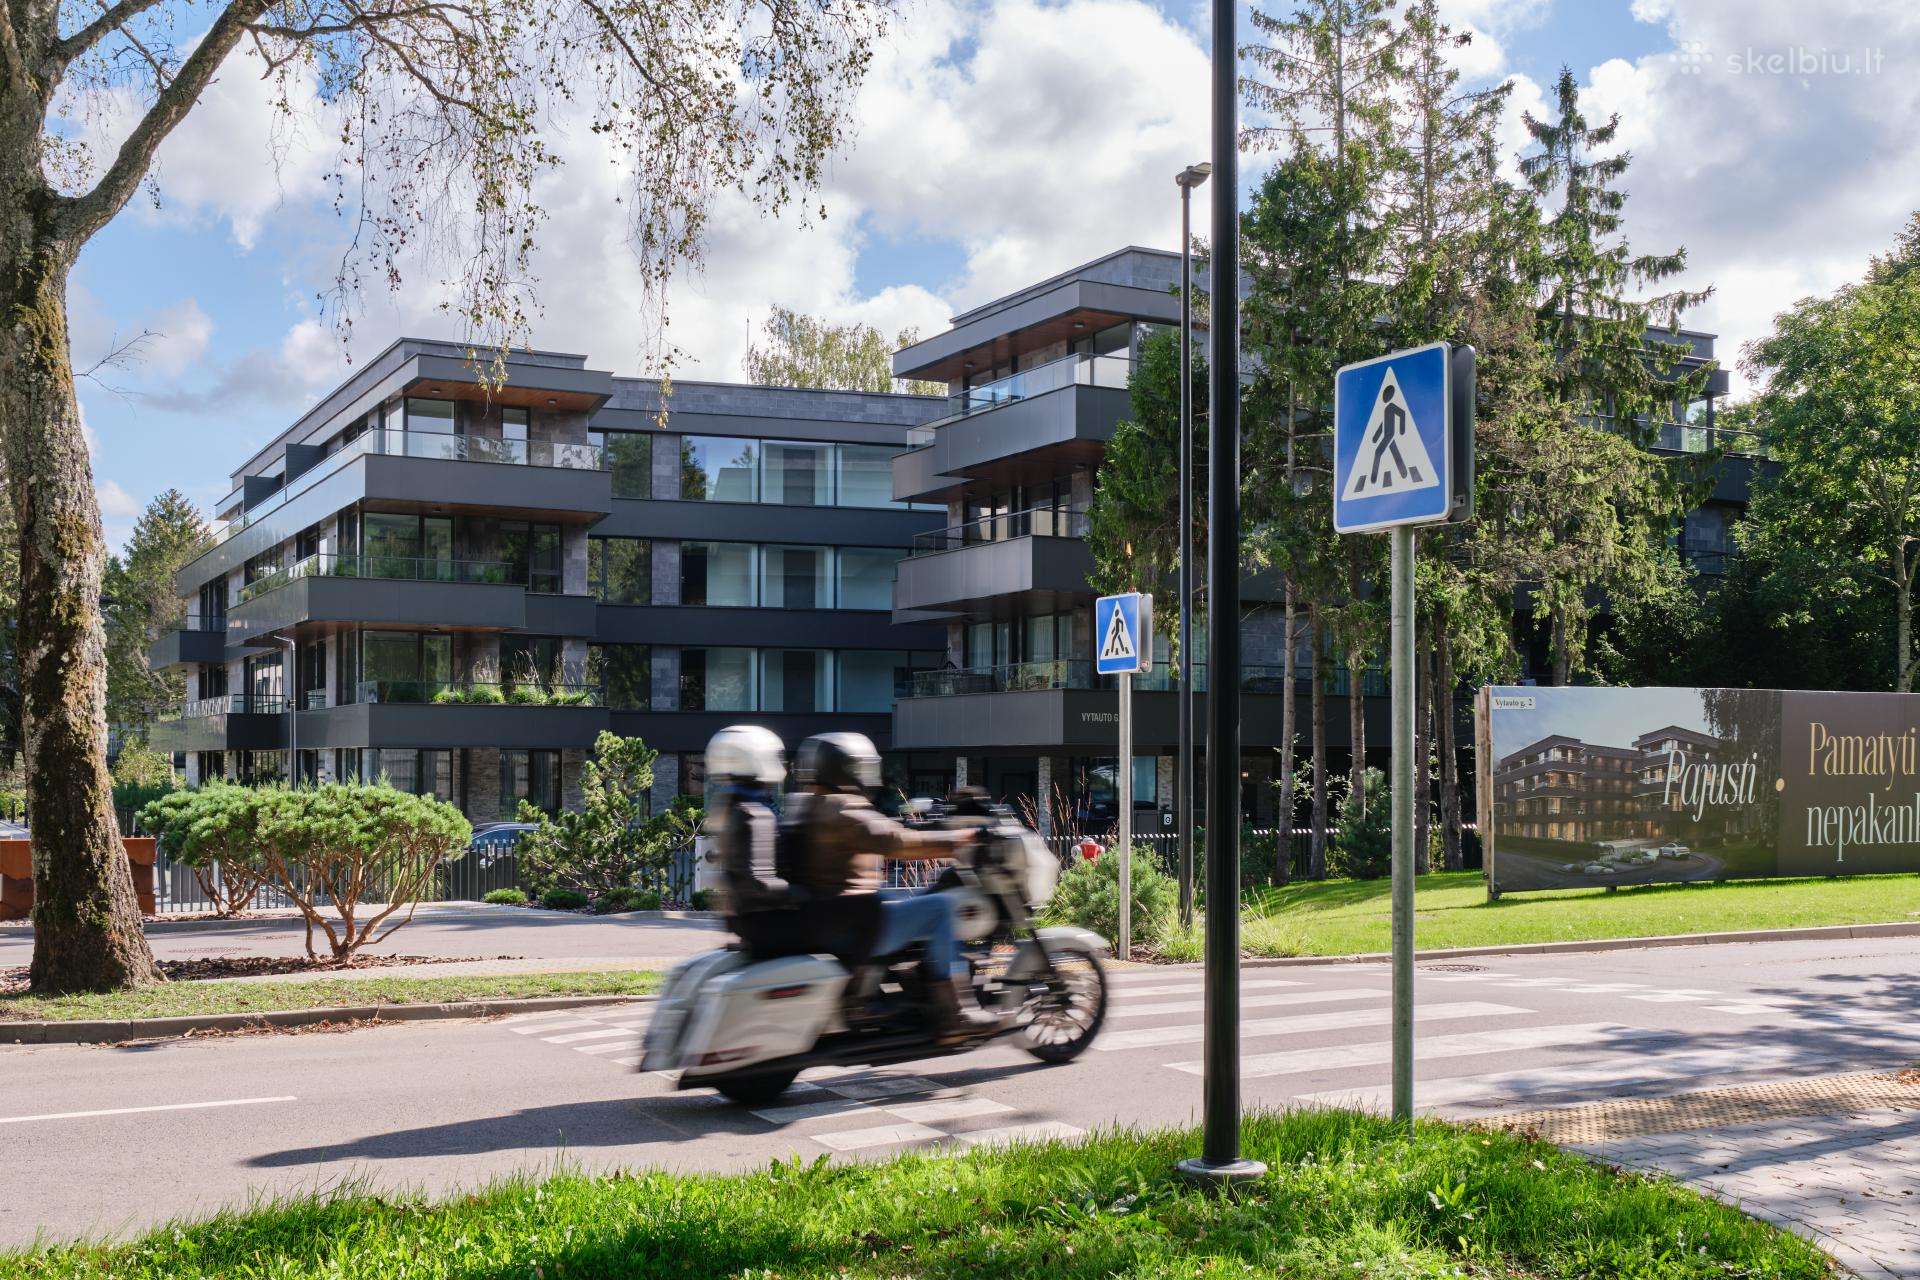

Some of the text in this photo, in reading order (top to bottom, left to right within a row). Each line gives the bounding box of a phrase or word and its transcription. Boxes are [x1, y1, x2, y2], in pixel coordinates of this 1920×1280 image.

[1081, 712, 1112, 722] VYTAUTO
[1495, 698, 1519, 708] Vytauto
[1808, 722, 1916, 791] Pamatyti
[1662, 749, 1758, 823] Pajusti
